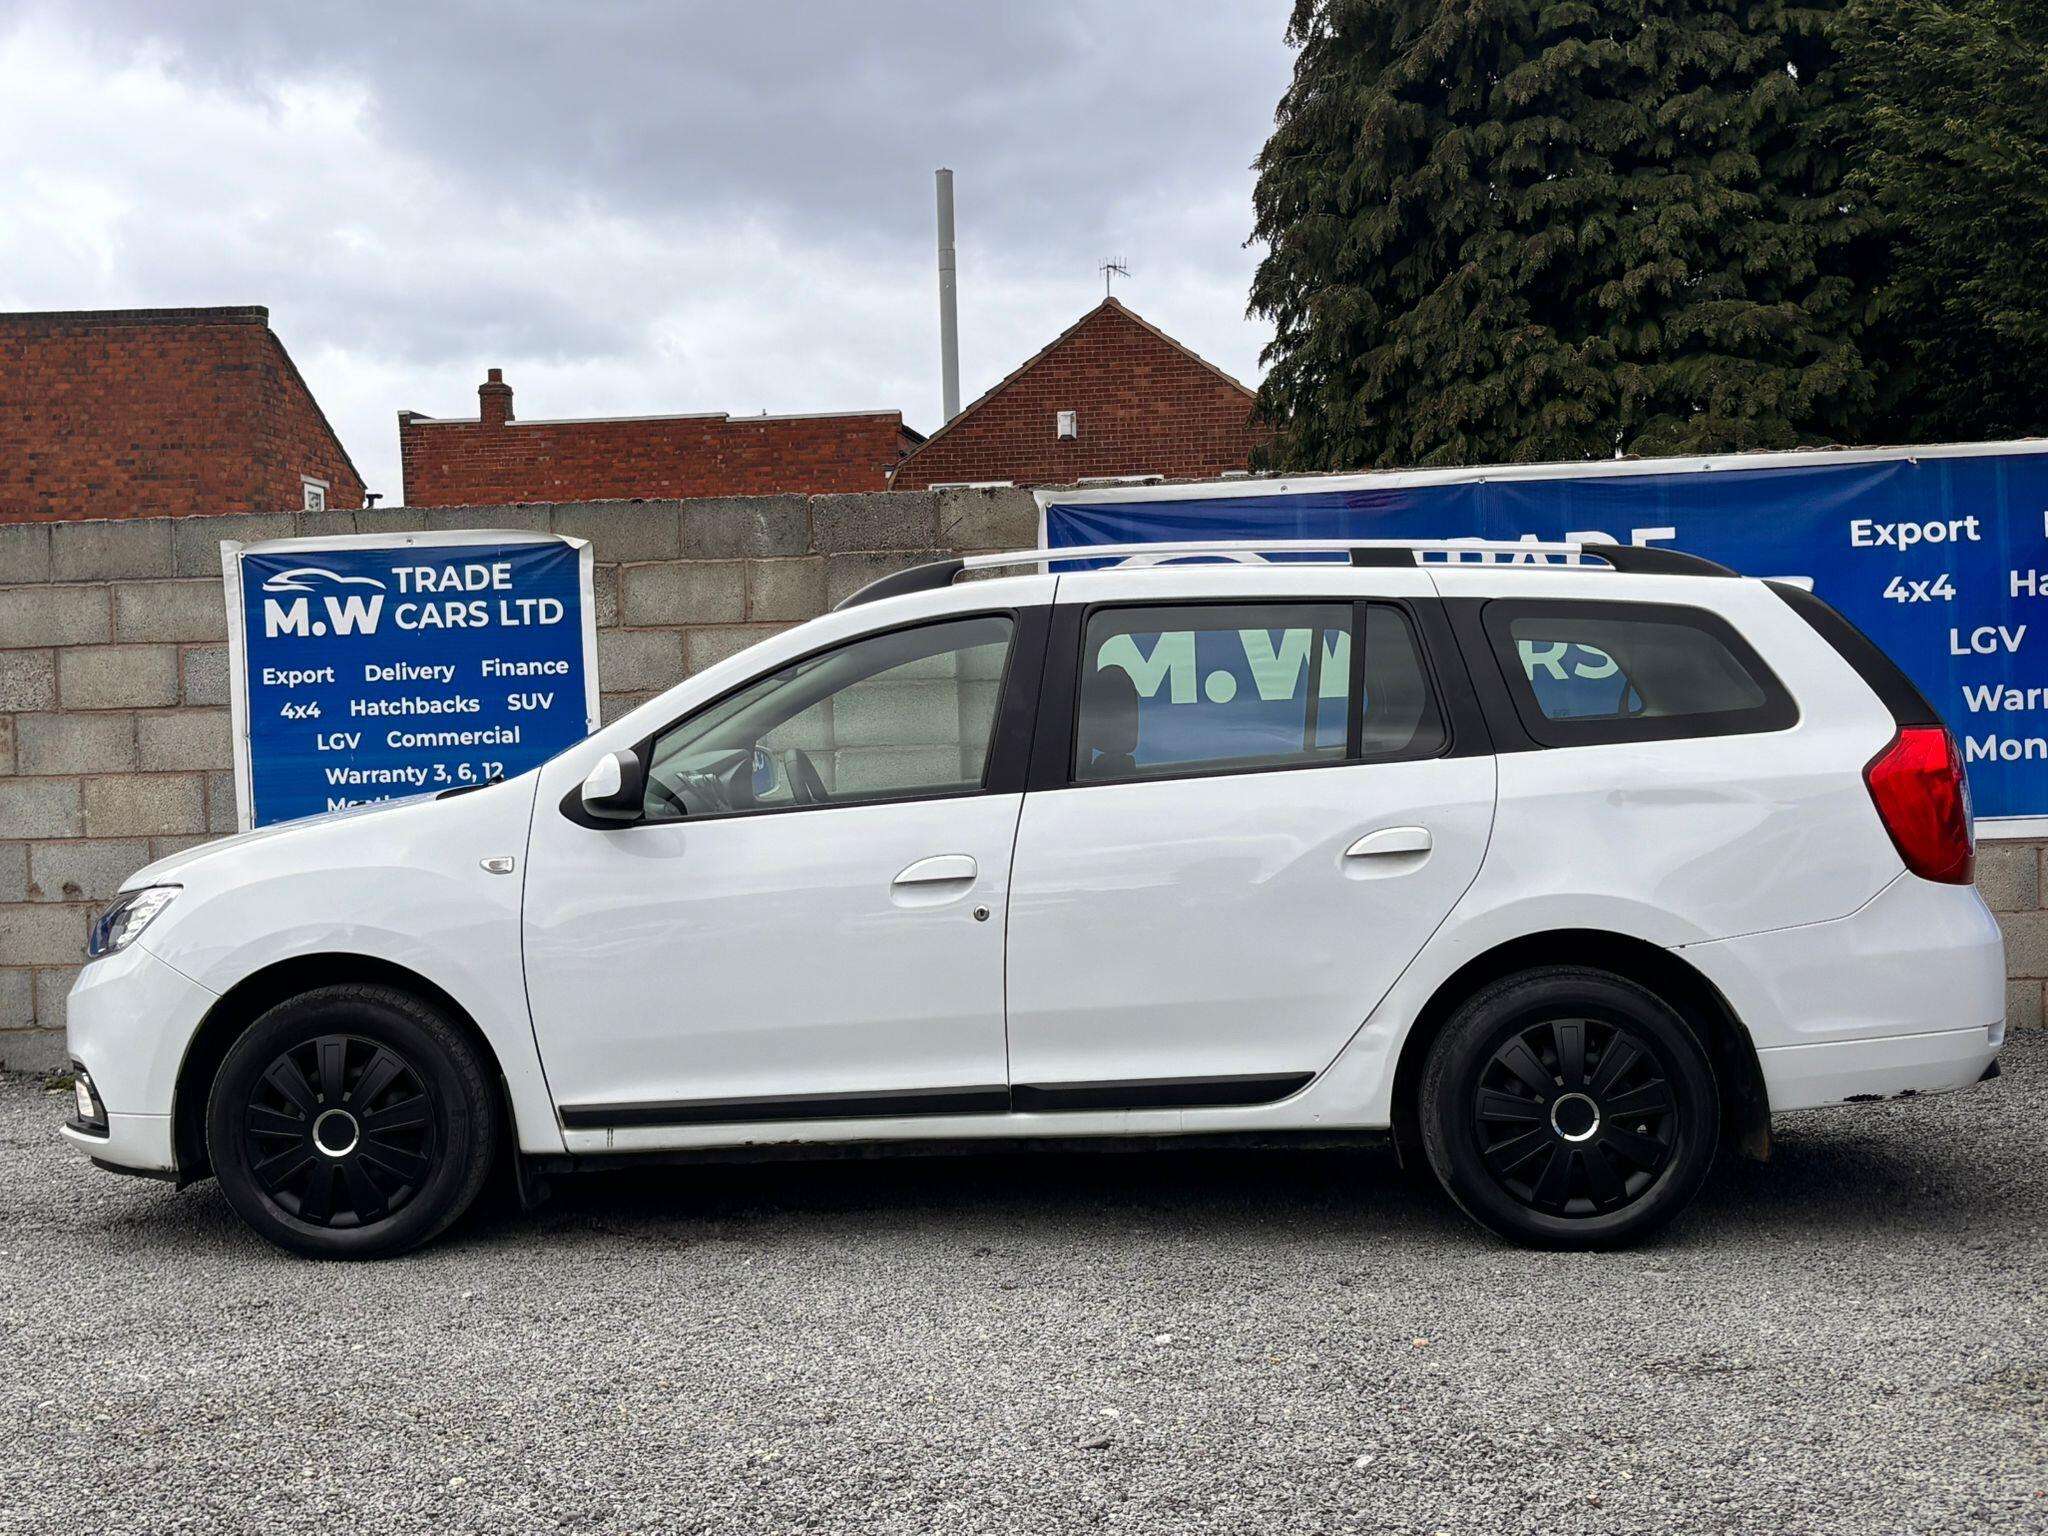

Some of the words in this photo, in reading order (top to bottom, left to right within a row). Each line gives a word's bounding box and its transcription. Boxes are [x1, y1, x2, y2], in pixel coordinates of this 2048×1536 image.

[1850, 515, 1981, 551] Export
[391, 562, 513, 593] TRADE
[1883, 573, 1957, 603] 4x4
[264, 595, 385, 637] M.W
[394, 601, 489, 630] CARS
[500, 598, 564, 626] LTD
[1950, 625, 2027, 655] LGV
[262, 667, 335, 688] Export
[365, 662, 456, 682] Delivery
[481, 657, 569, 677] Finance
[280, 702, 321, 719] 4x4
[350, 696, 480, 717] Hatchbacks
[507, 692, 554, 711] SUV
[317, 732, 361, 751] LGV
[386, 726, 520, 748] Commercial
[325, 767, 428, 786] Warranty
[433, 765, 452, 783] 3,
[457, 763, 477, 782] 6,
